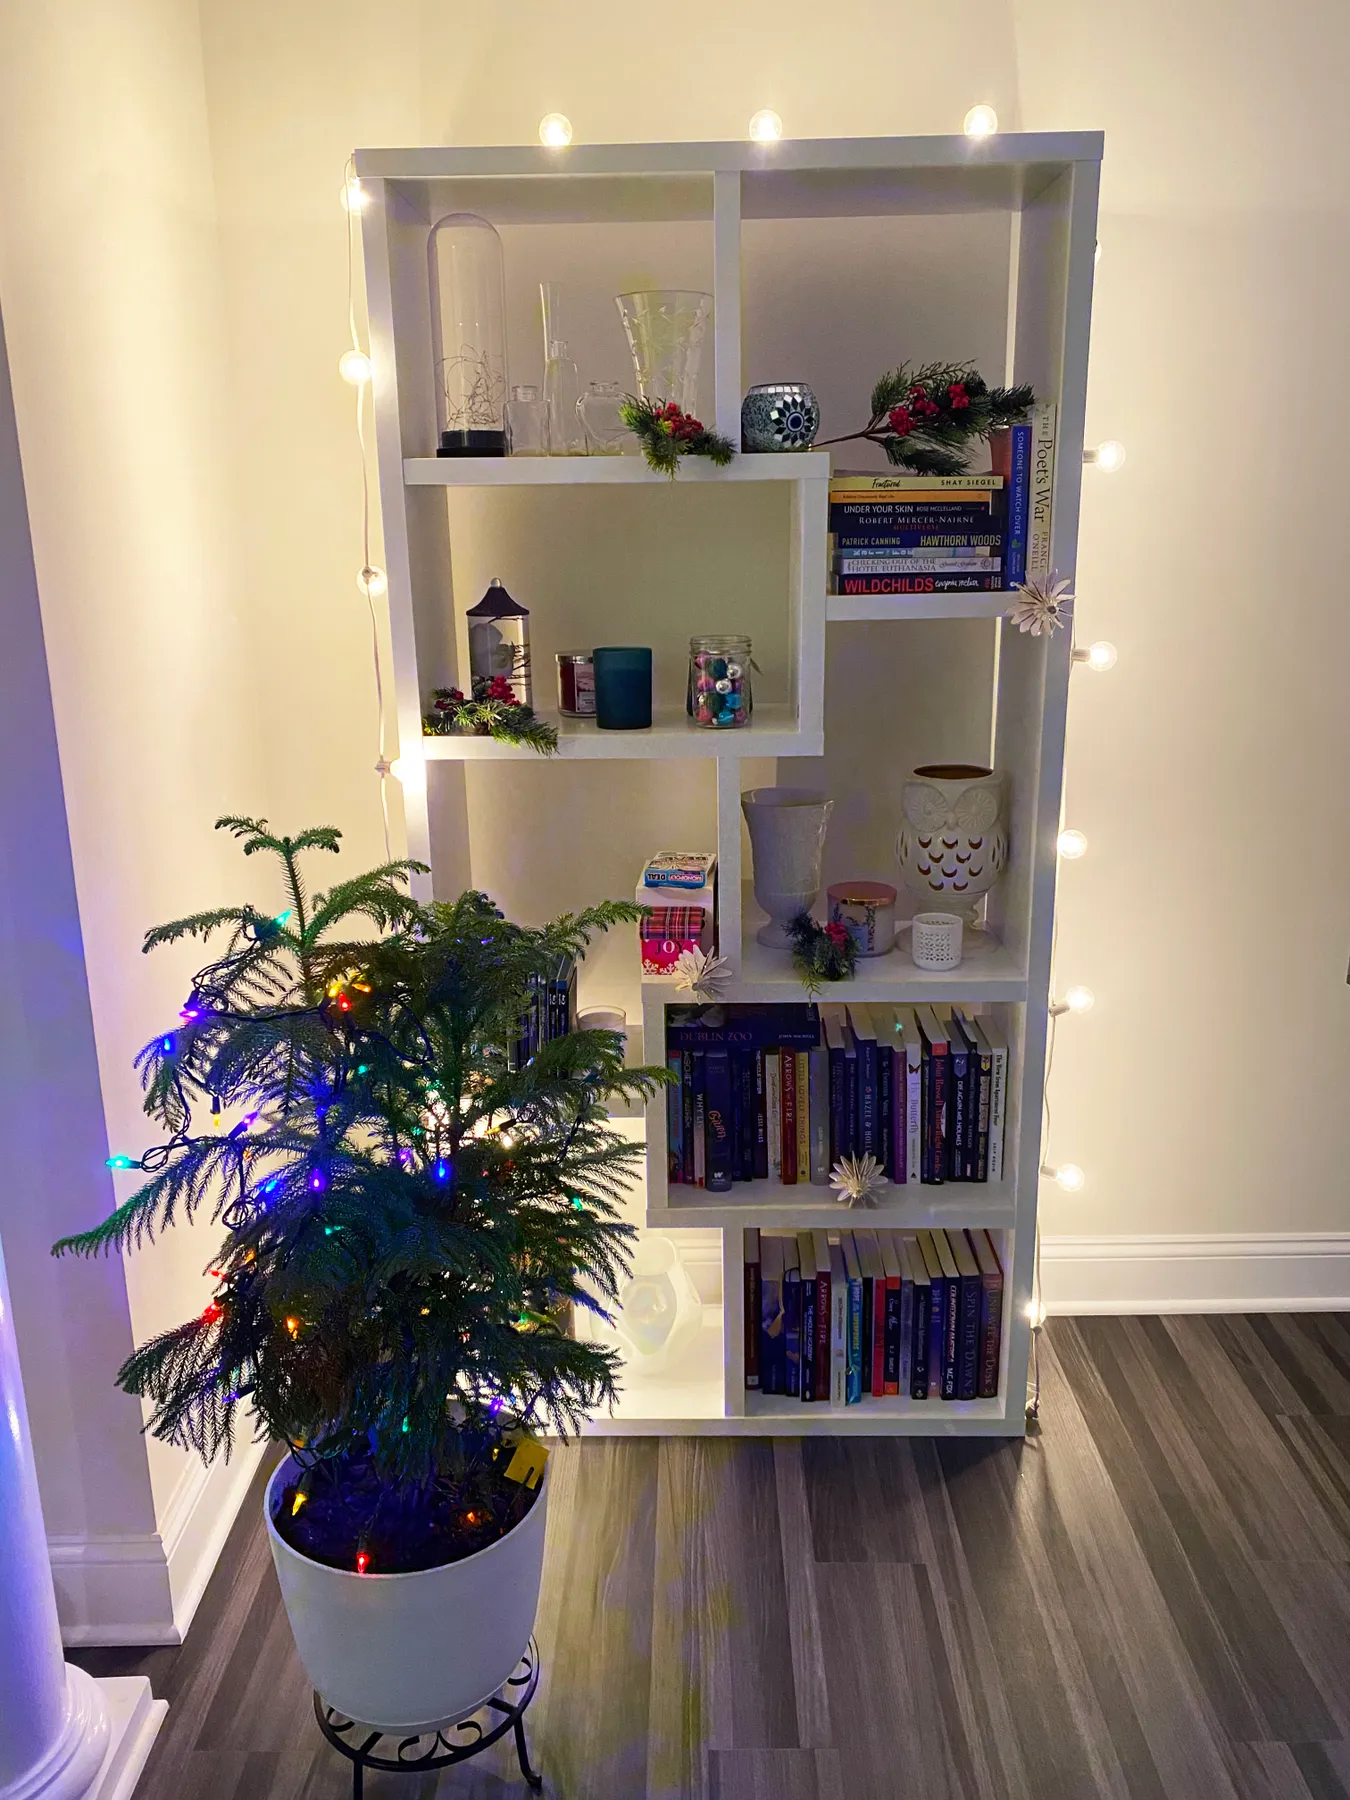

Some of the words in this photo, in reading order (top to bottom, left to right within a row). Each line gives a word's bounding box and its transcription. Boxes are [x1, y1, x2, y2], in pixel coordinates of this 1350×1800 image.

[1016, 432, 1024, 470] SOMEONE
[1036, 439, 1053, 484] Poet's
[872, 478, 901, 489] Fractured
[1016, 473, 1023, 483] TO
[844, 505, 871, 513] UNDER
[872, 505, 893, 513] YOUR
[895, 504, 914, 513] SKIN
[1034, 487, 1050, 522] War
[842, 538, 869, 546] PATRICK
[871, 537, 901, 545] CANNING
[920, 535, 968, 546] HAWTHORN
[970, 535, 1002, 546] WOODS
[1031, 533, 1040, 572] O'NEILL
[844, 578, 934, 593] WILDCHILDS
[654, 940, 684, 954] JOY
[680, 1031, 724, 1041] DUBLIN
[728, 1031, 752, 1041] ZOO
[784, 1055, 793, 1092] ARROWS
[935, 1058, 944, 1077] John
[935, 1079, 945, 1106] Russell
[909, 1099, 919, 1134] Butterfly
[818, 1281, 828, 1315] ARROWS
[948, 1285, 957, 1331] COUNTDOWN
[966, 1292, 977, 1317] SPIN
[986, 1290, 998, 1336] UNRAVEL
[818, 1324, 826, 1345] FIRE
[947, 1332, 955, 1362] AMERICA
[966, 1323, 975, 1346] THE
[964, 1351, 976, 1387] DAWN
[984, 1359, 996, 1384] DUSK
